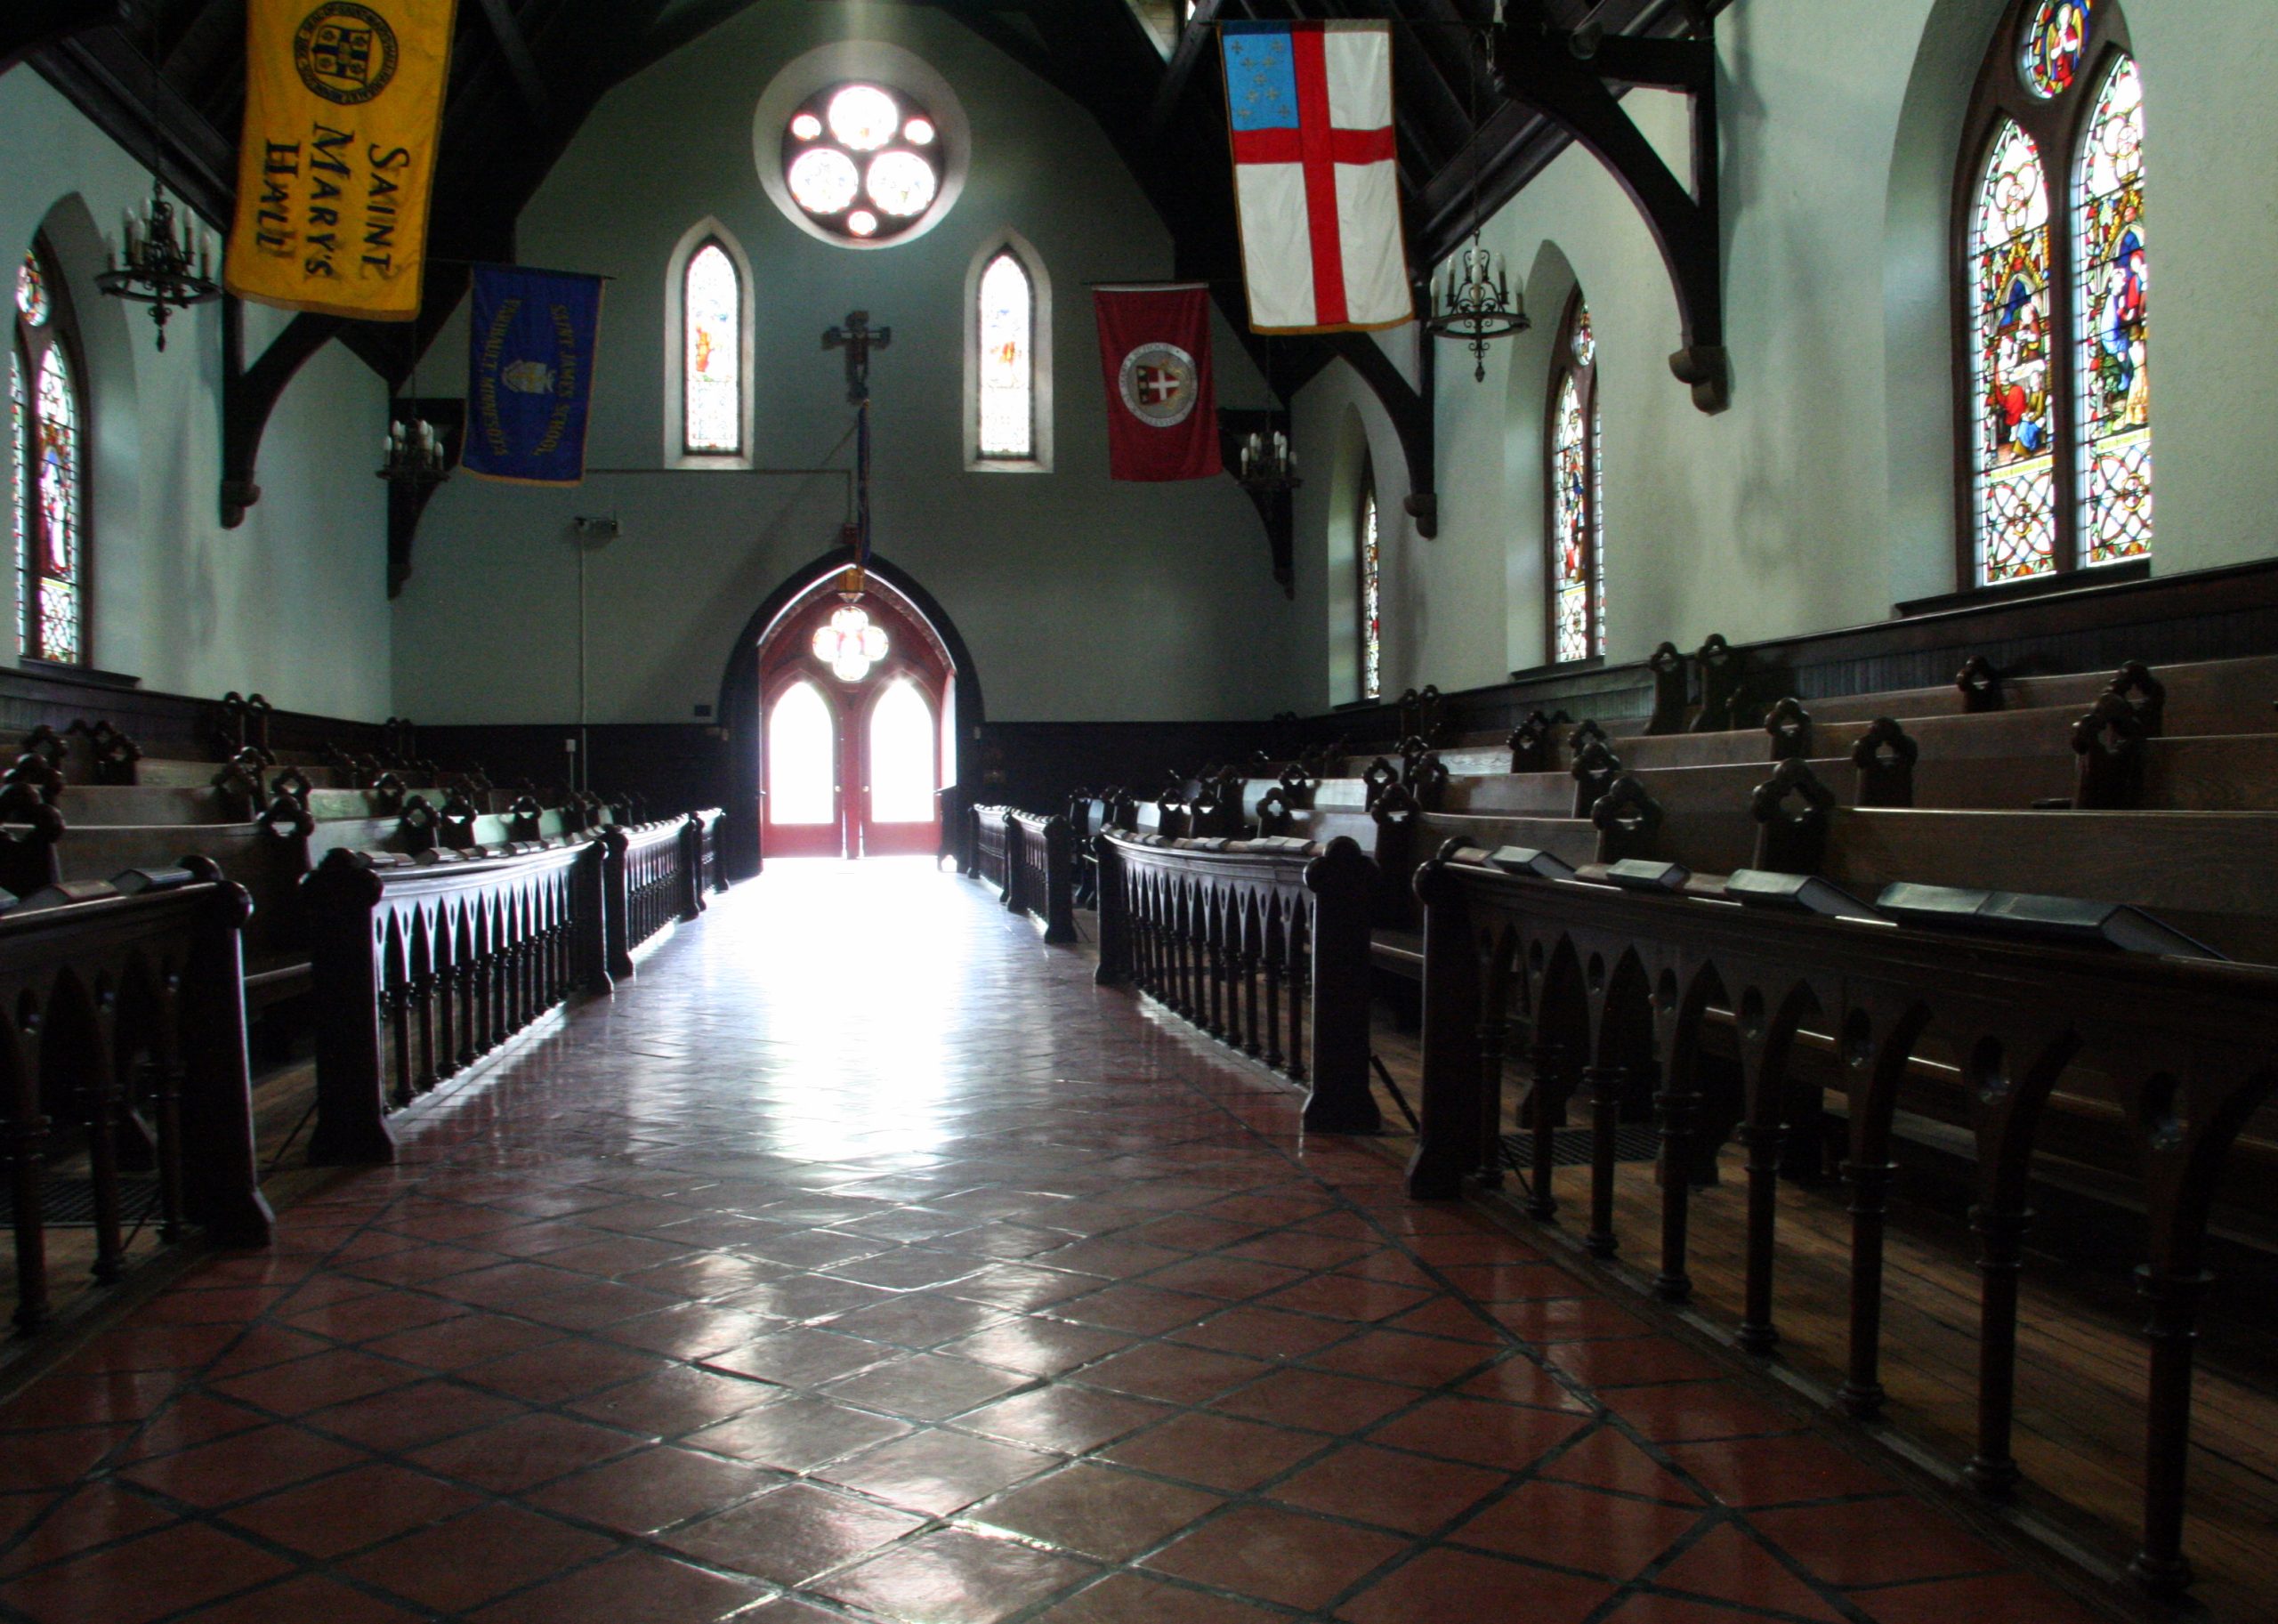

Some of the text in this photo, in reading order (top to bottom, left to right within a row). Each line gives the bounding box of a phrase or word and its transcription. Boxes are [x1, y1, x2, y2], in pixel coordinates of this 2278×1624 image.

[256, 139, 300, 249] HALL
[305, 122, 356, 278] MARY'S
[361, 142, 411, 271] SAINT
[481, 376, 509, 456] MINNESOTA
[532, 303, 578, 456] SAINT JAMES SCHOOL
